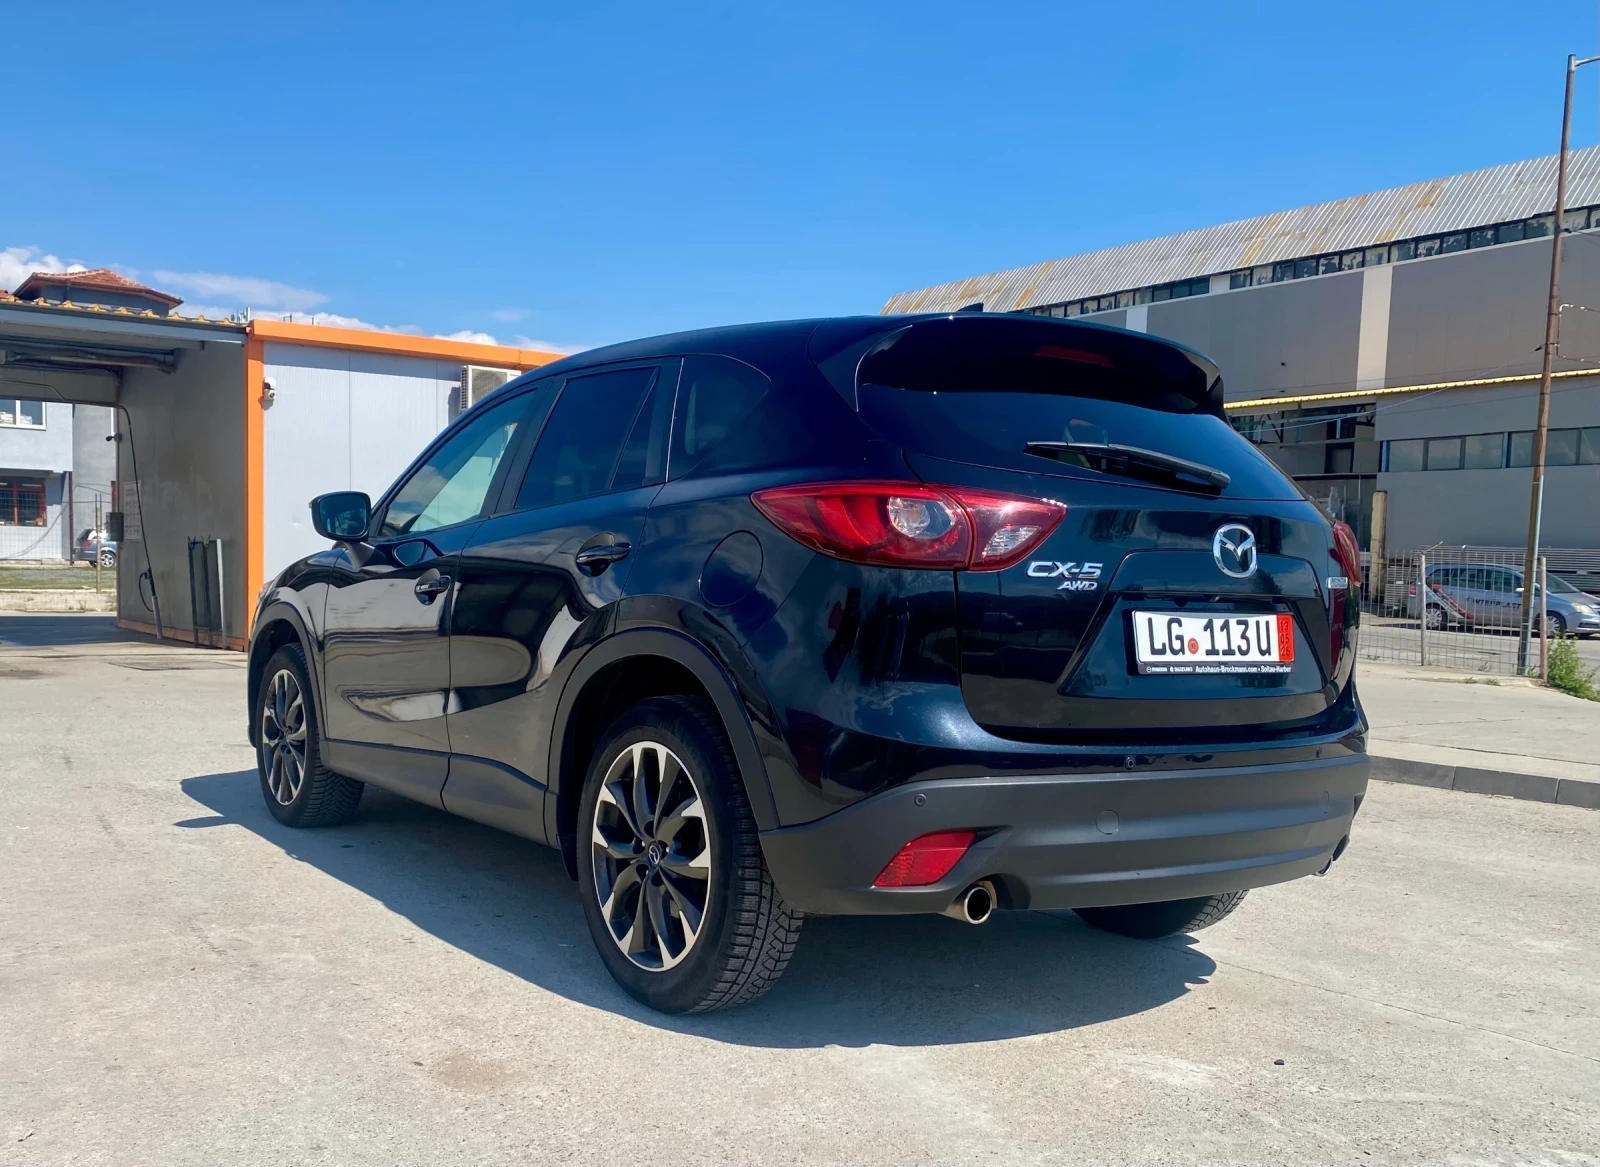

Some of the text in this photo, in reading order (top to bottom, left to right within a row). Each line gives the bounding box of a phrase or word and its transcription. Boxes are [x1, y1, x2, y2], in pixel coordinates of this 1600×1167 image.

[1026, 561, 1103, 579] CX-5
[1057, 580, 1098, 591] AWD
[1279, 620, 1289, 632] 13
[1147, 617, 1185, 656] LG
[1280, 633, 1290, 644] 05
